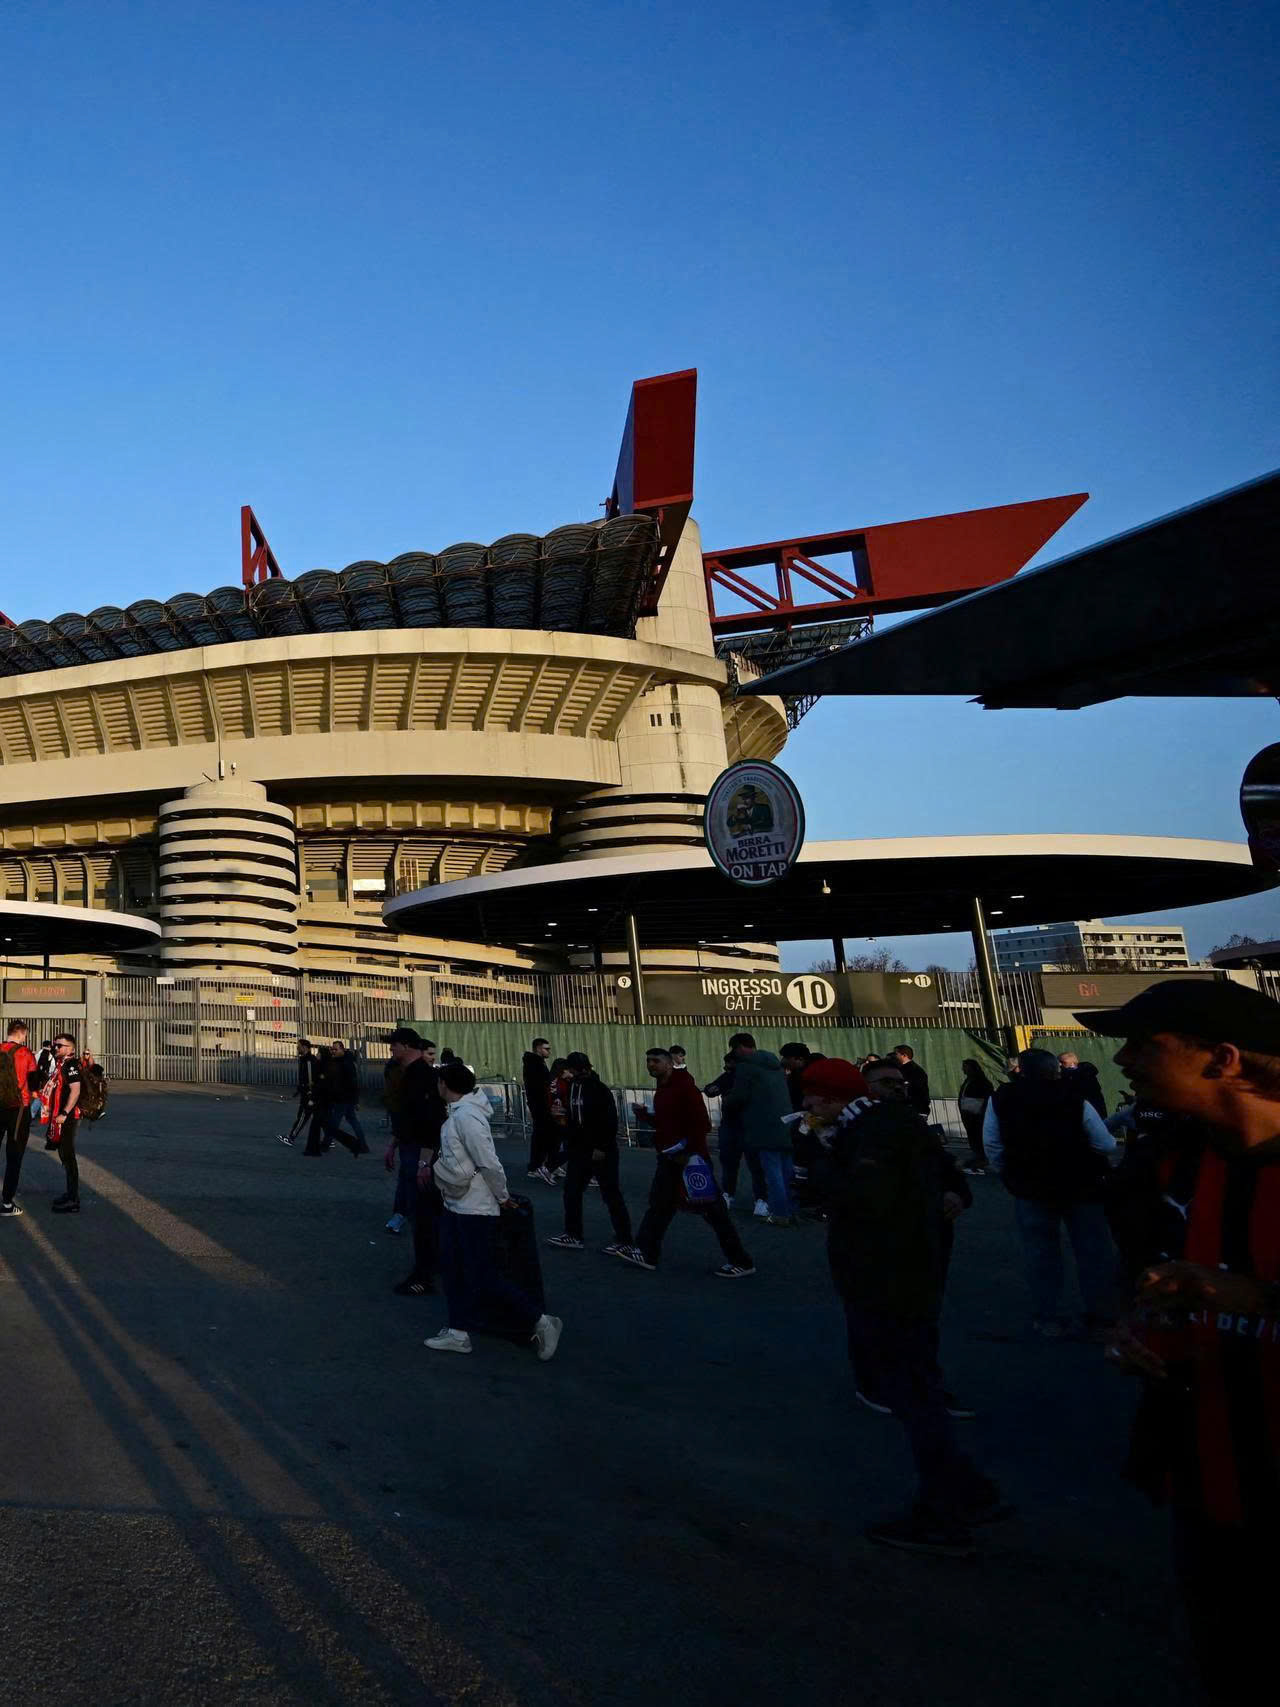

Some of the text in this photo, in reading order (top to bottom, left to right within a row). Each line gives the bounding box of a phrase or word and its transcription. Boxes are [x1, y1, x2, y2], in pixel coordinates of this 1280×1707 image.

[737, 835, 771, 848] BIRRA
[726, 842, 786, 861] MORETTI
[730, 861, 788, 879] ON TAP
[701, 978, 827, 1010] INGRESSO 10
[724, 995, 762, 1011] GATE
